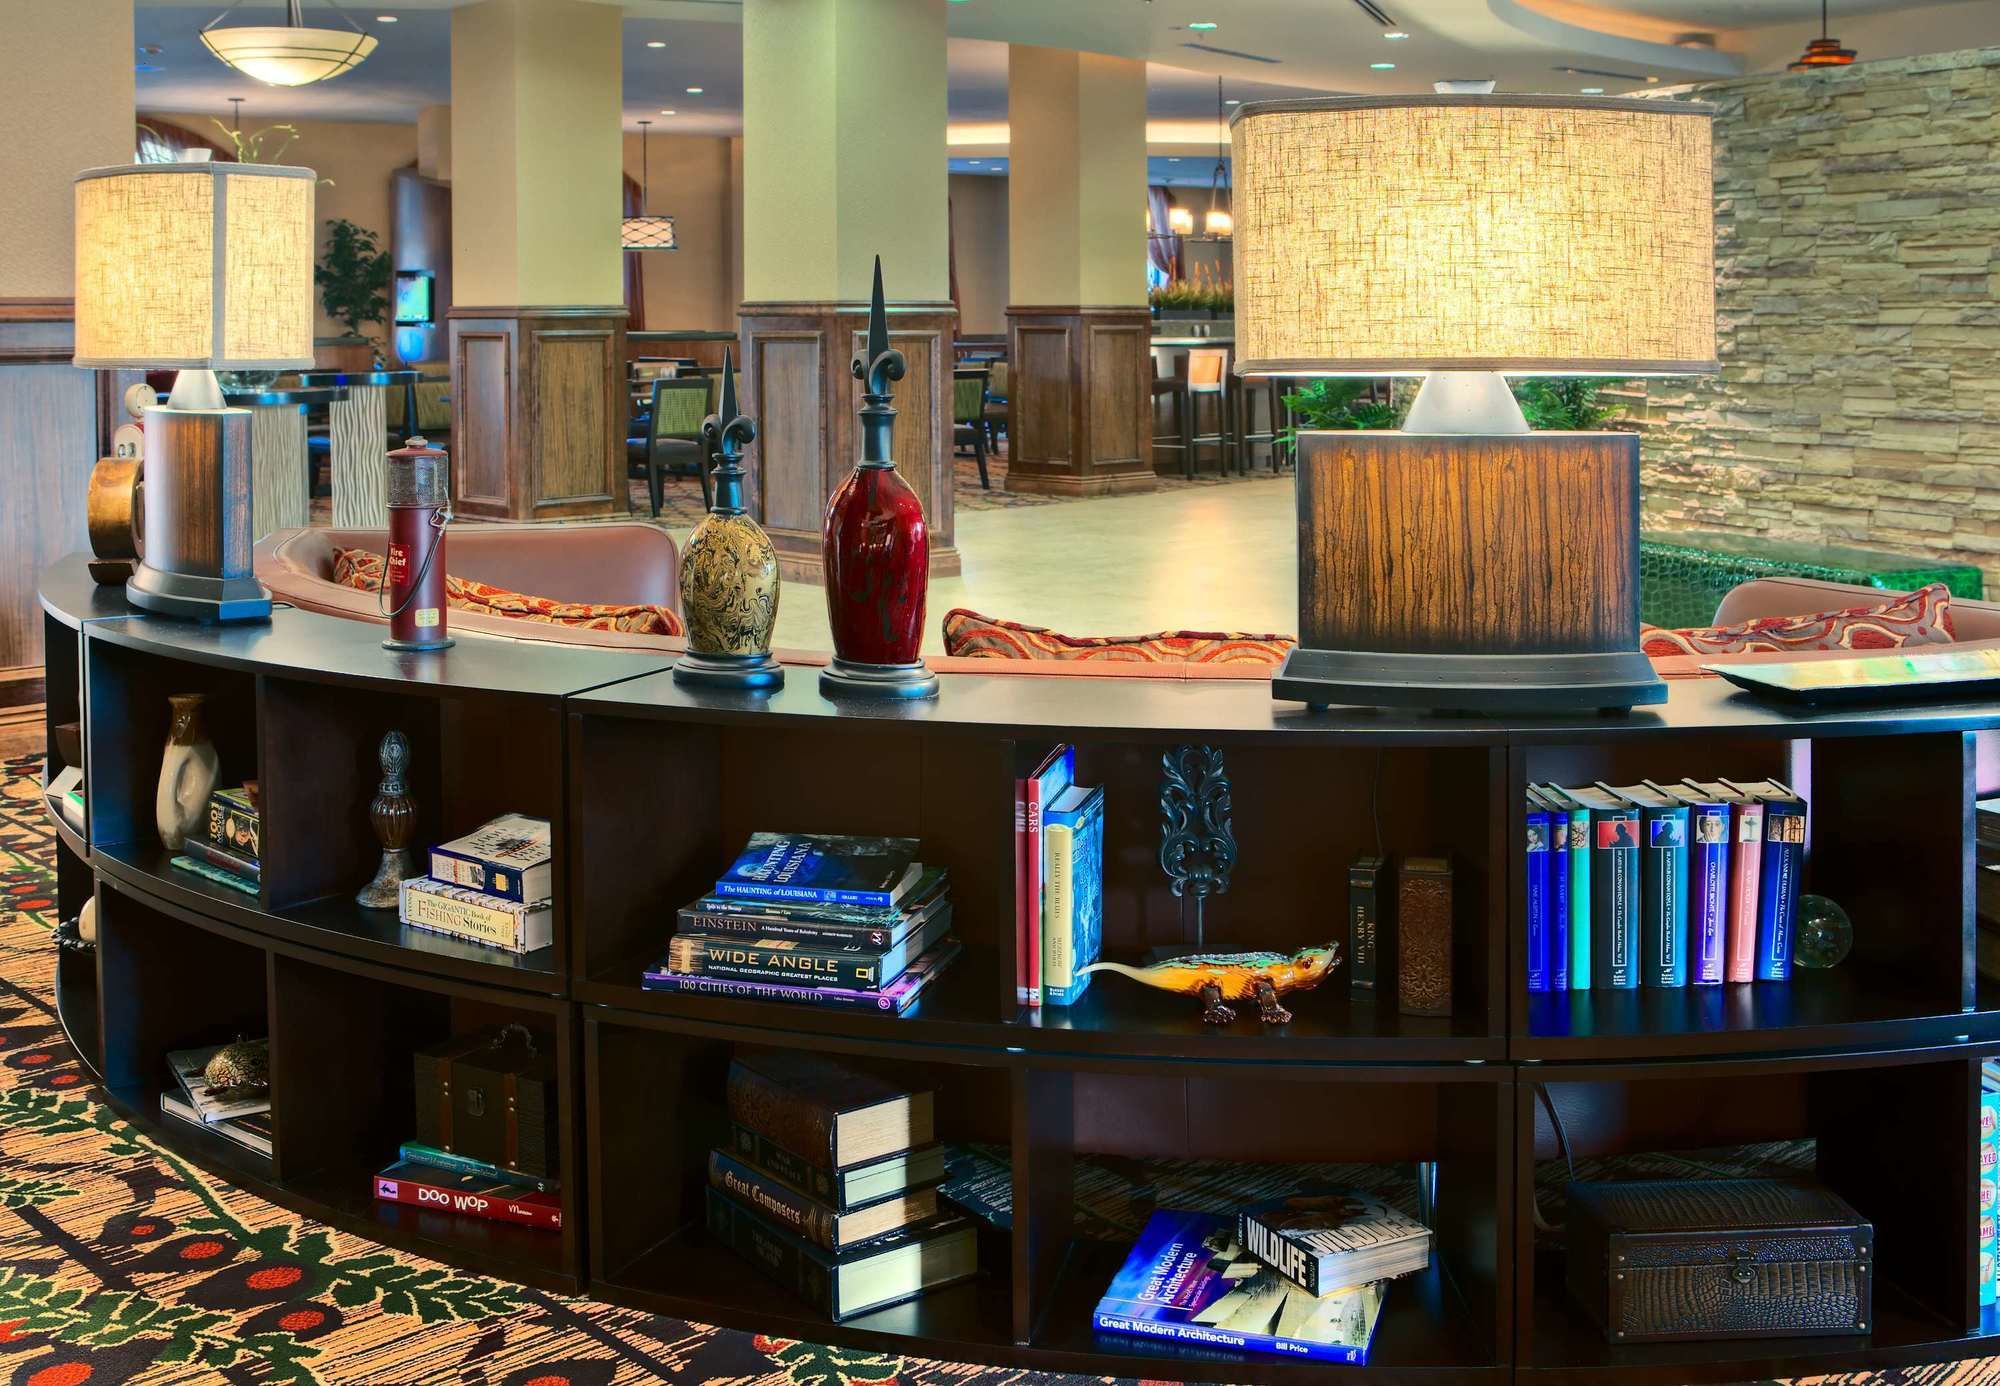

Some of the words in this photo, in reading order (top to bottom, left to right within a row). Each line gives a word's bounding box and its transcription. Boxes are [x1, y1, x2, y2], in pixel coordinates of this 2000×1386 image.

[390, 556, 406, 567] Chief
[391, 547, 404, 557] Fire
[210, 802, 219, 839] 1001
[1028, 801, 1039, 833] CARS
[752, 841, 790, 880] HAUNTING
[773, 842, 812, 883] LOUISIANA
[724, 885, 736, 893] The
[736, 886, 772, 895] HAUNTING
[773, 888, 781, 896] of
[781, 889, 818, 899] LOUISIANA
[418, 899, 461, 927] FISHING
[463, 917, 497, 936] Stories
[427, 900, 436, 908] The
[437, 901, 470, 916] GIGANTIC
[471, 911, 484, 919] Book
[693, 916, 757, 932] EINSTEIN
[1357, 905, 1365, 940] HENRY
[1367, 922, 1376, 951] KING
[708, 948, 760, 966] WIDE
[767, 954, 839, 973] ANGLE
[1357, 945, 1365, 964] VIII
[708, 965, 737, 974] NATIONAL
[739, 967, 780, 977] GEOGRAPHIC
[781, 971, 812, 980] GREATEST
[814, 974, 838, 982] PLACES
[679, 979, 696, 990] 100
[699, 981, 734, 993] CITIES
[736, 984, 751, 995] OF
[754, 986, 777, 998] THE
[780, 989, 823, 1001] WORLD
[418, 1187, 450, 1205] DOO
[454, 1195, 488, 1212] WOP
[725, 1170, 750, 1197] Great
[752, 1183, 800, 1225] Composers
[1301, 1216, 1428, 1255] WILDLIFE
[1246, 1216, 1307, 1288] WILDLIFE
[1138, 1274, 1163, 1301] Great
[1152, 1242, 1184, 1277] Modern
[1156, 1251, 1198, 1304] Architecture
[1100, 1317, 1130, 1331] Great
[1133, 1321, 1175, 1337] Modern
[1178, 1328, 1245, 1346] Architecture
[1276, 1342, 1288, 1350] Bill
[1289, 1343, 1308, 1354] Price
